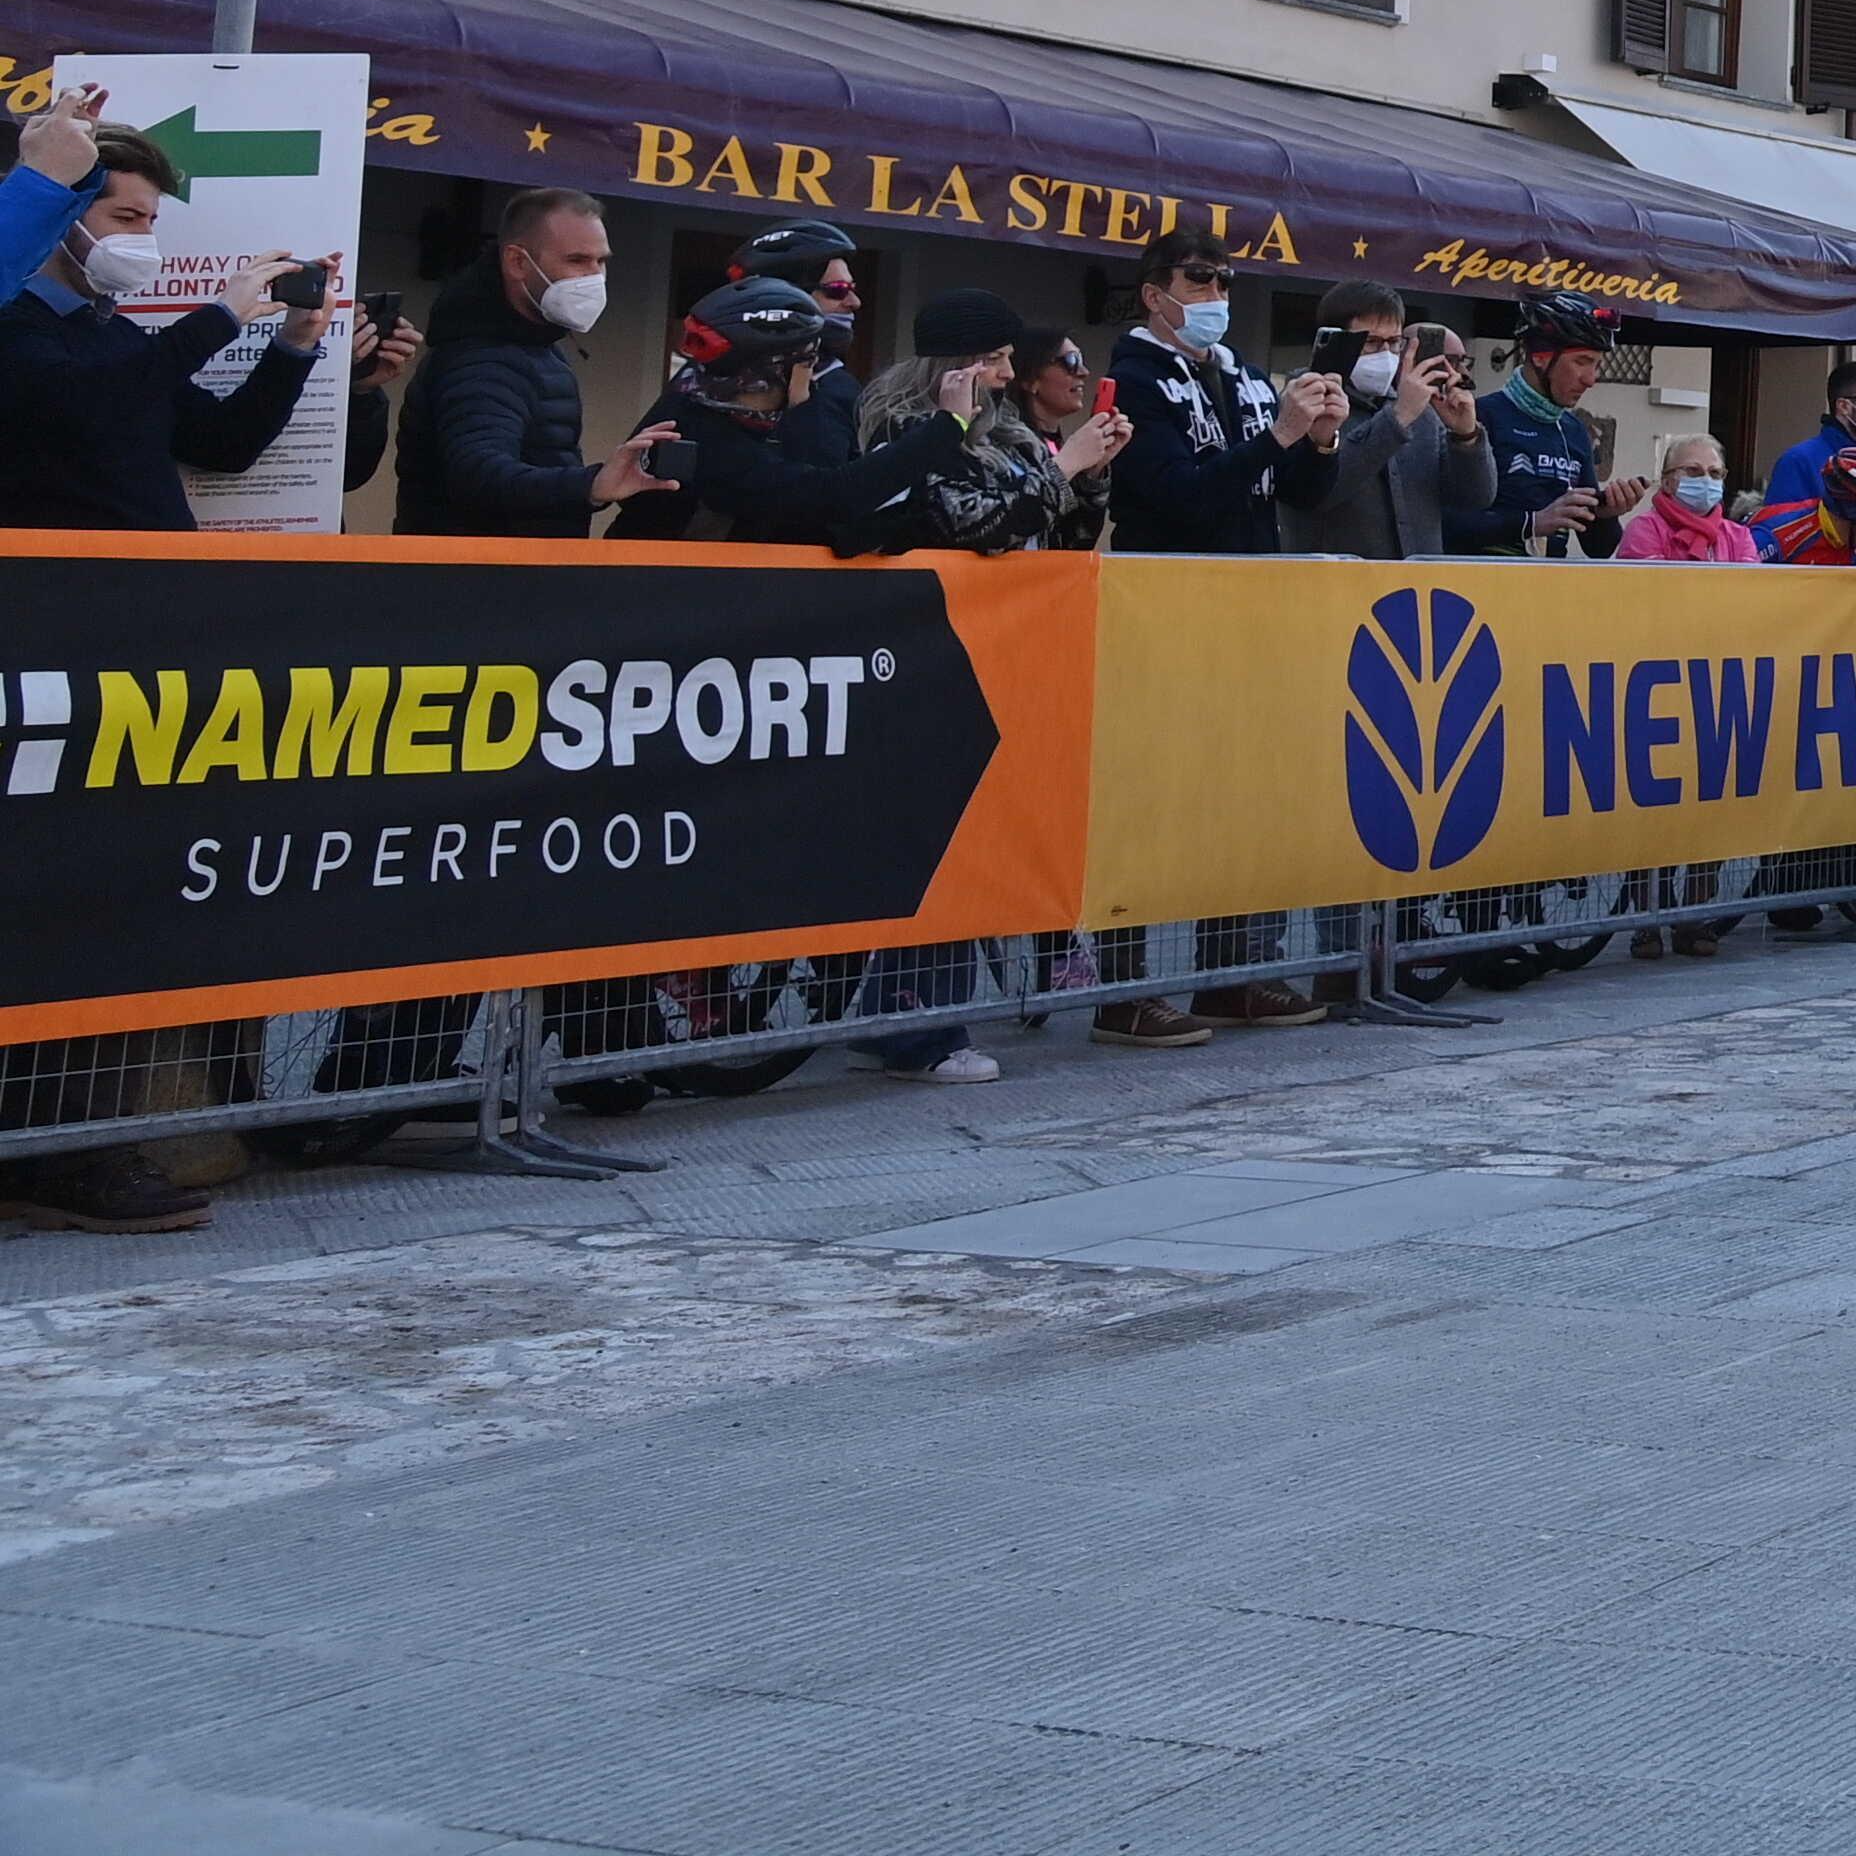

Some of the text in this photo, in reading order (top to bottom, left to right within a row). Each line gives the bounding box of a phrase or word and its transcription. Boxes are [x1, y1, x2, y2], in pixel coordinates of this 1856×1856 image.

[629, 122, 834, 207] BAR
[864, 154, 985, 225] LA
[1414, 239, 1682, 306] Aperitiveria
[742, 308, 795, 322] MET
[1542, 656, 1776, 817] NEW
[180, 809, 697, 902] SUPERFOOD
